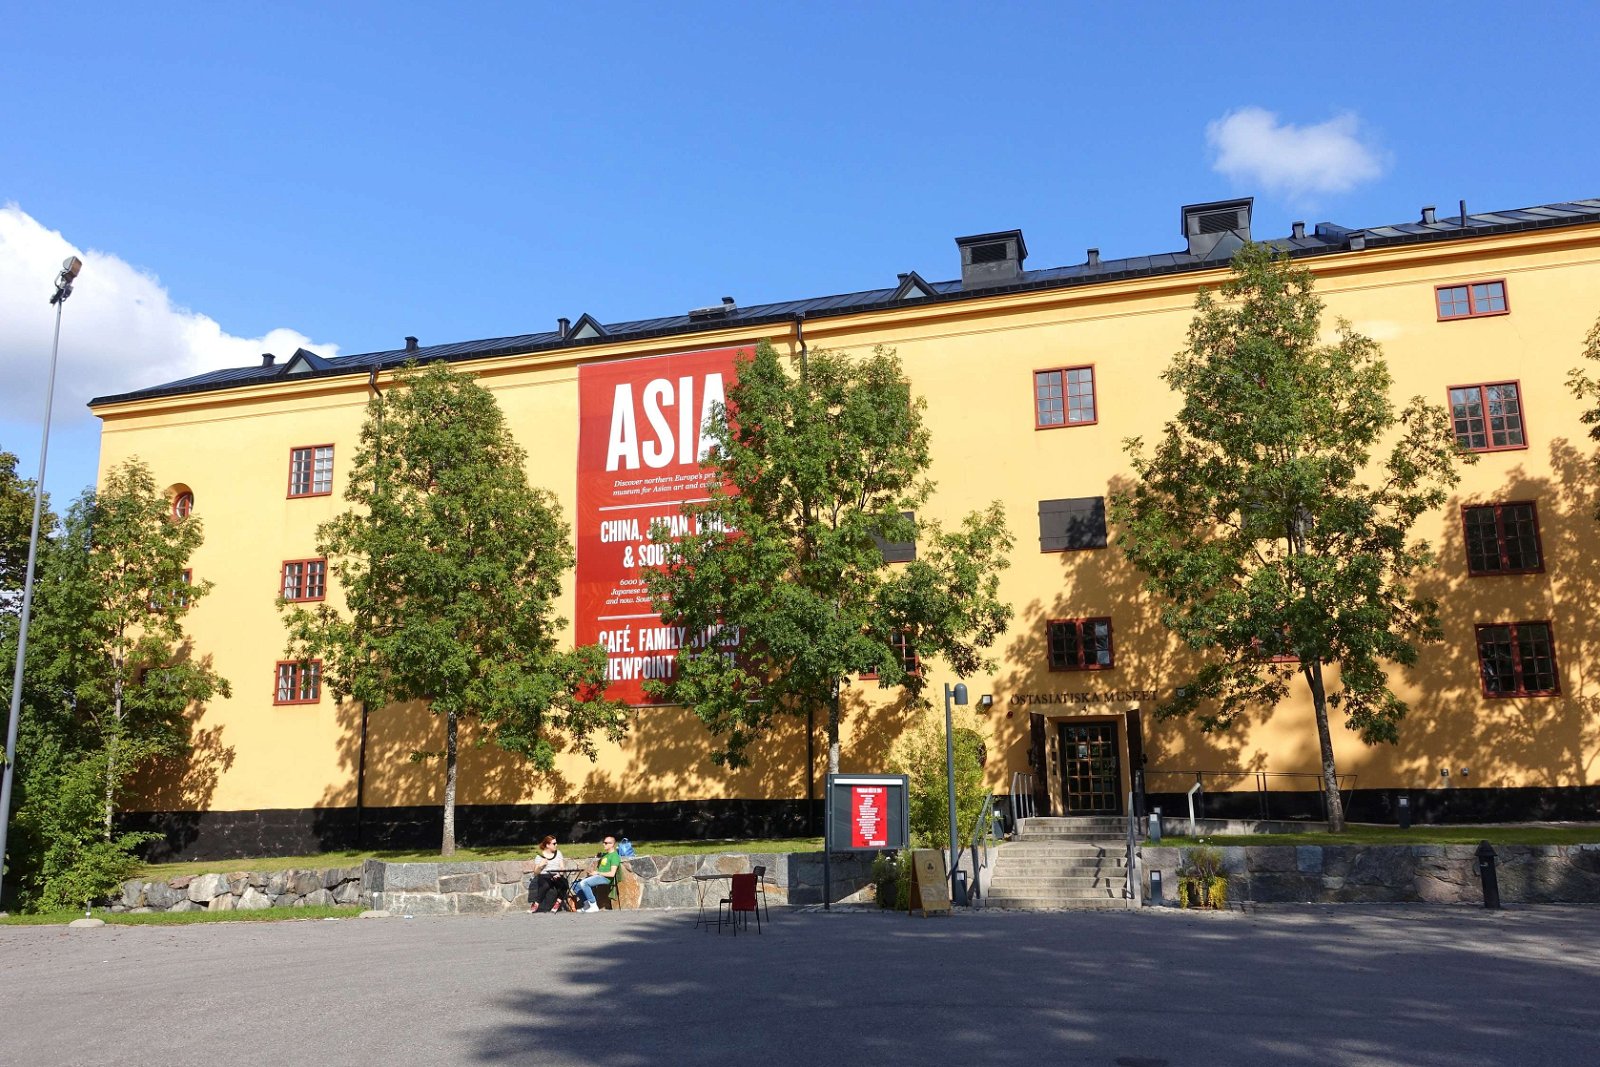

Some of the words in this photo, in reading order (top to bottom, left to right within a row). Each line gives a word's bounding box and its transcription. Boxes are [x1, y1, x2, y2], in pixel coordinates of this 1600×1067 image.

[606, 373, 731, 471] ASIA
[614, 479, 642, 487] Discover
[644, 476, 672, 484] northern
[674, 472, 702, 481] Europe's
[641, 487, 652, 495] for
[652, 485, 672, 493] Asian
[685, 481, 698, 489] and
[600, 518, 643, 543] CHINA,
[623, 545, 634, 568] &
[610, 588, 641, 596] Japanese
[605, 597, 619, 605] and
[599, 624, 635, 654] CAFÉ,
[639, 627, 687, 652] FAMILY
[1103, 690, 1158, 703] MUSEET
